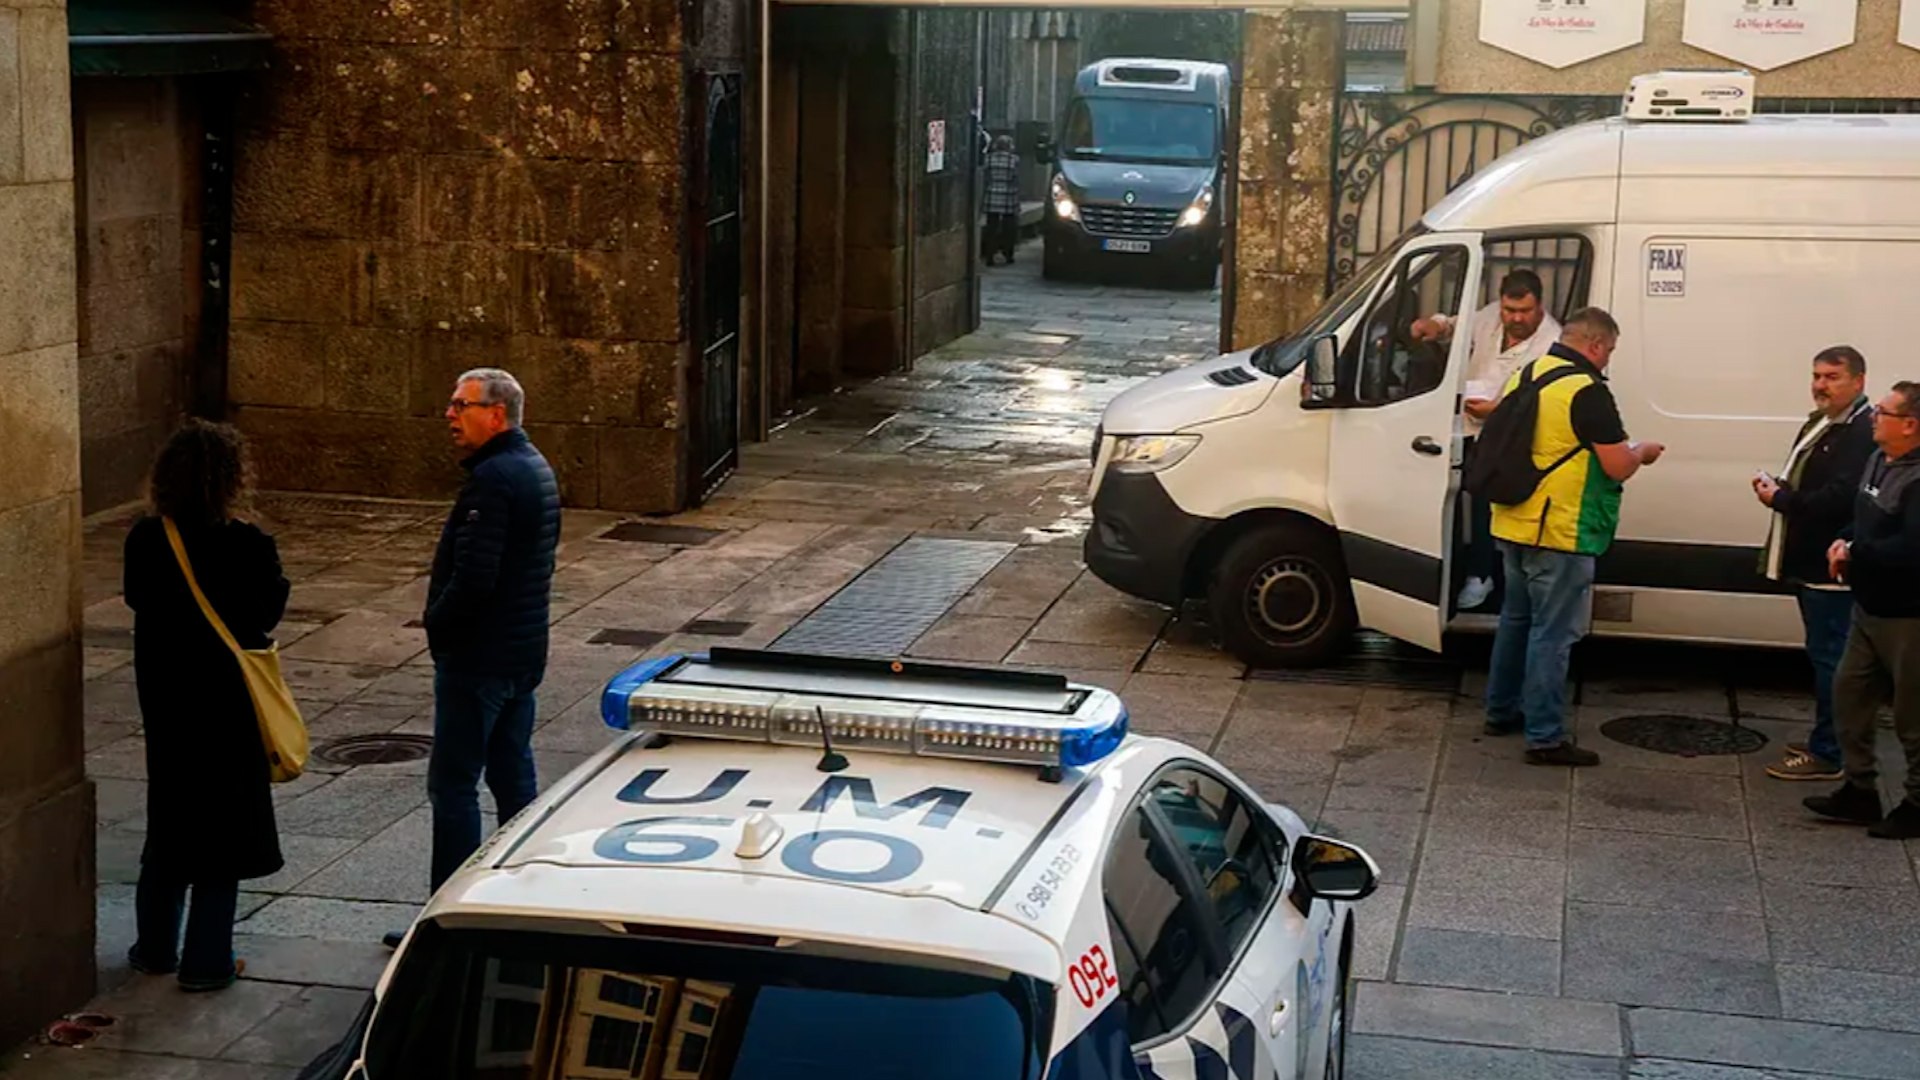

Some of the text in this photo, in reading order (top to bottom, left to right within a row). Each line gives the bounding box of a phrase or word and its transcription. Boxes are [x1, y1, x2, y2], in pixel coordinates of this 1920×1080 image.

[1650, 248, 1684, 270] FRAX
[616, 769, 1003, 839] U.M.
[593, 816, 924, 883] 60
[1026, 883, 1051, 909] 981
[1040, 868, 1063, 890] 54
[1068, 944, 1117, 1009] 092
